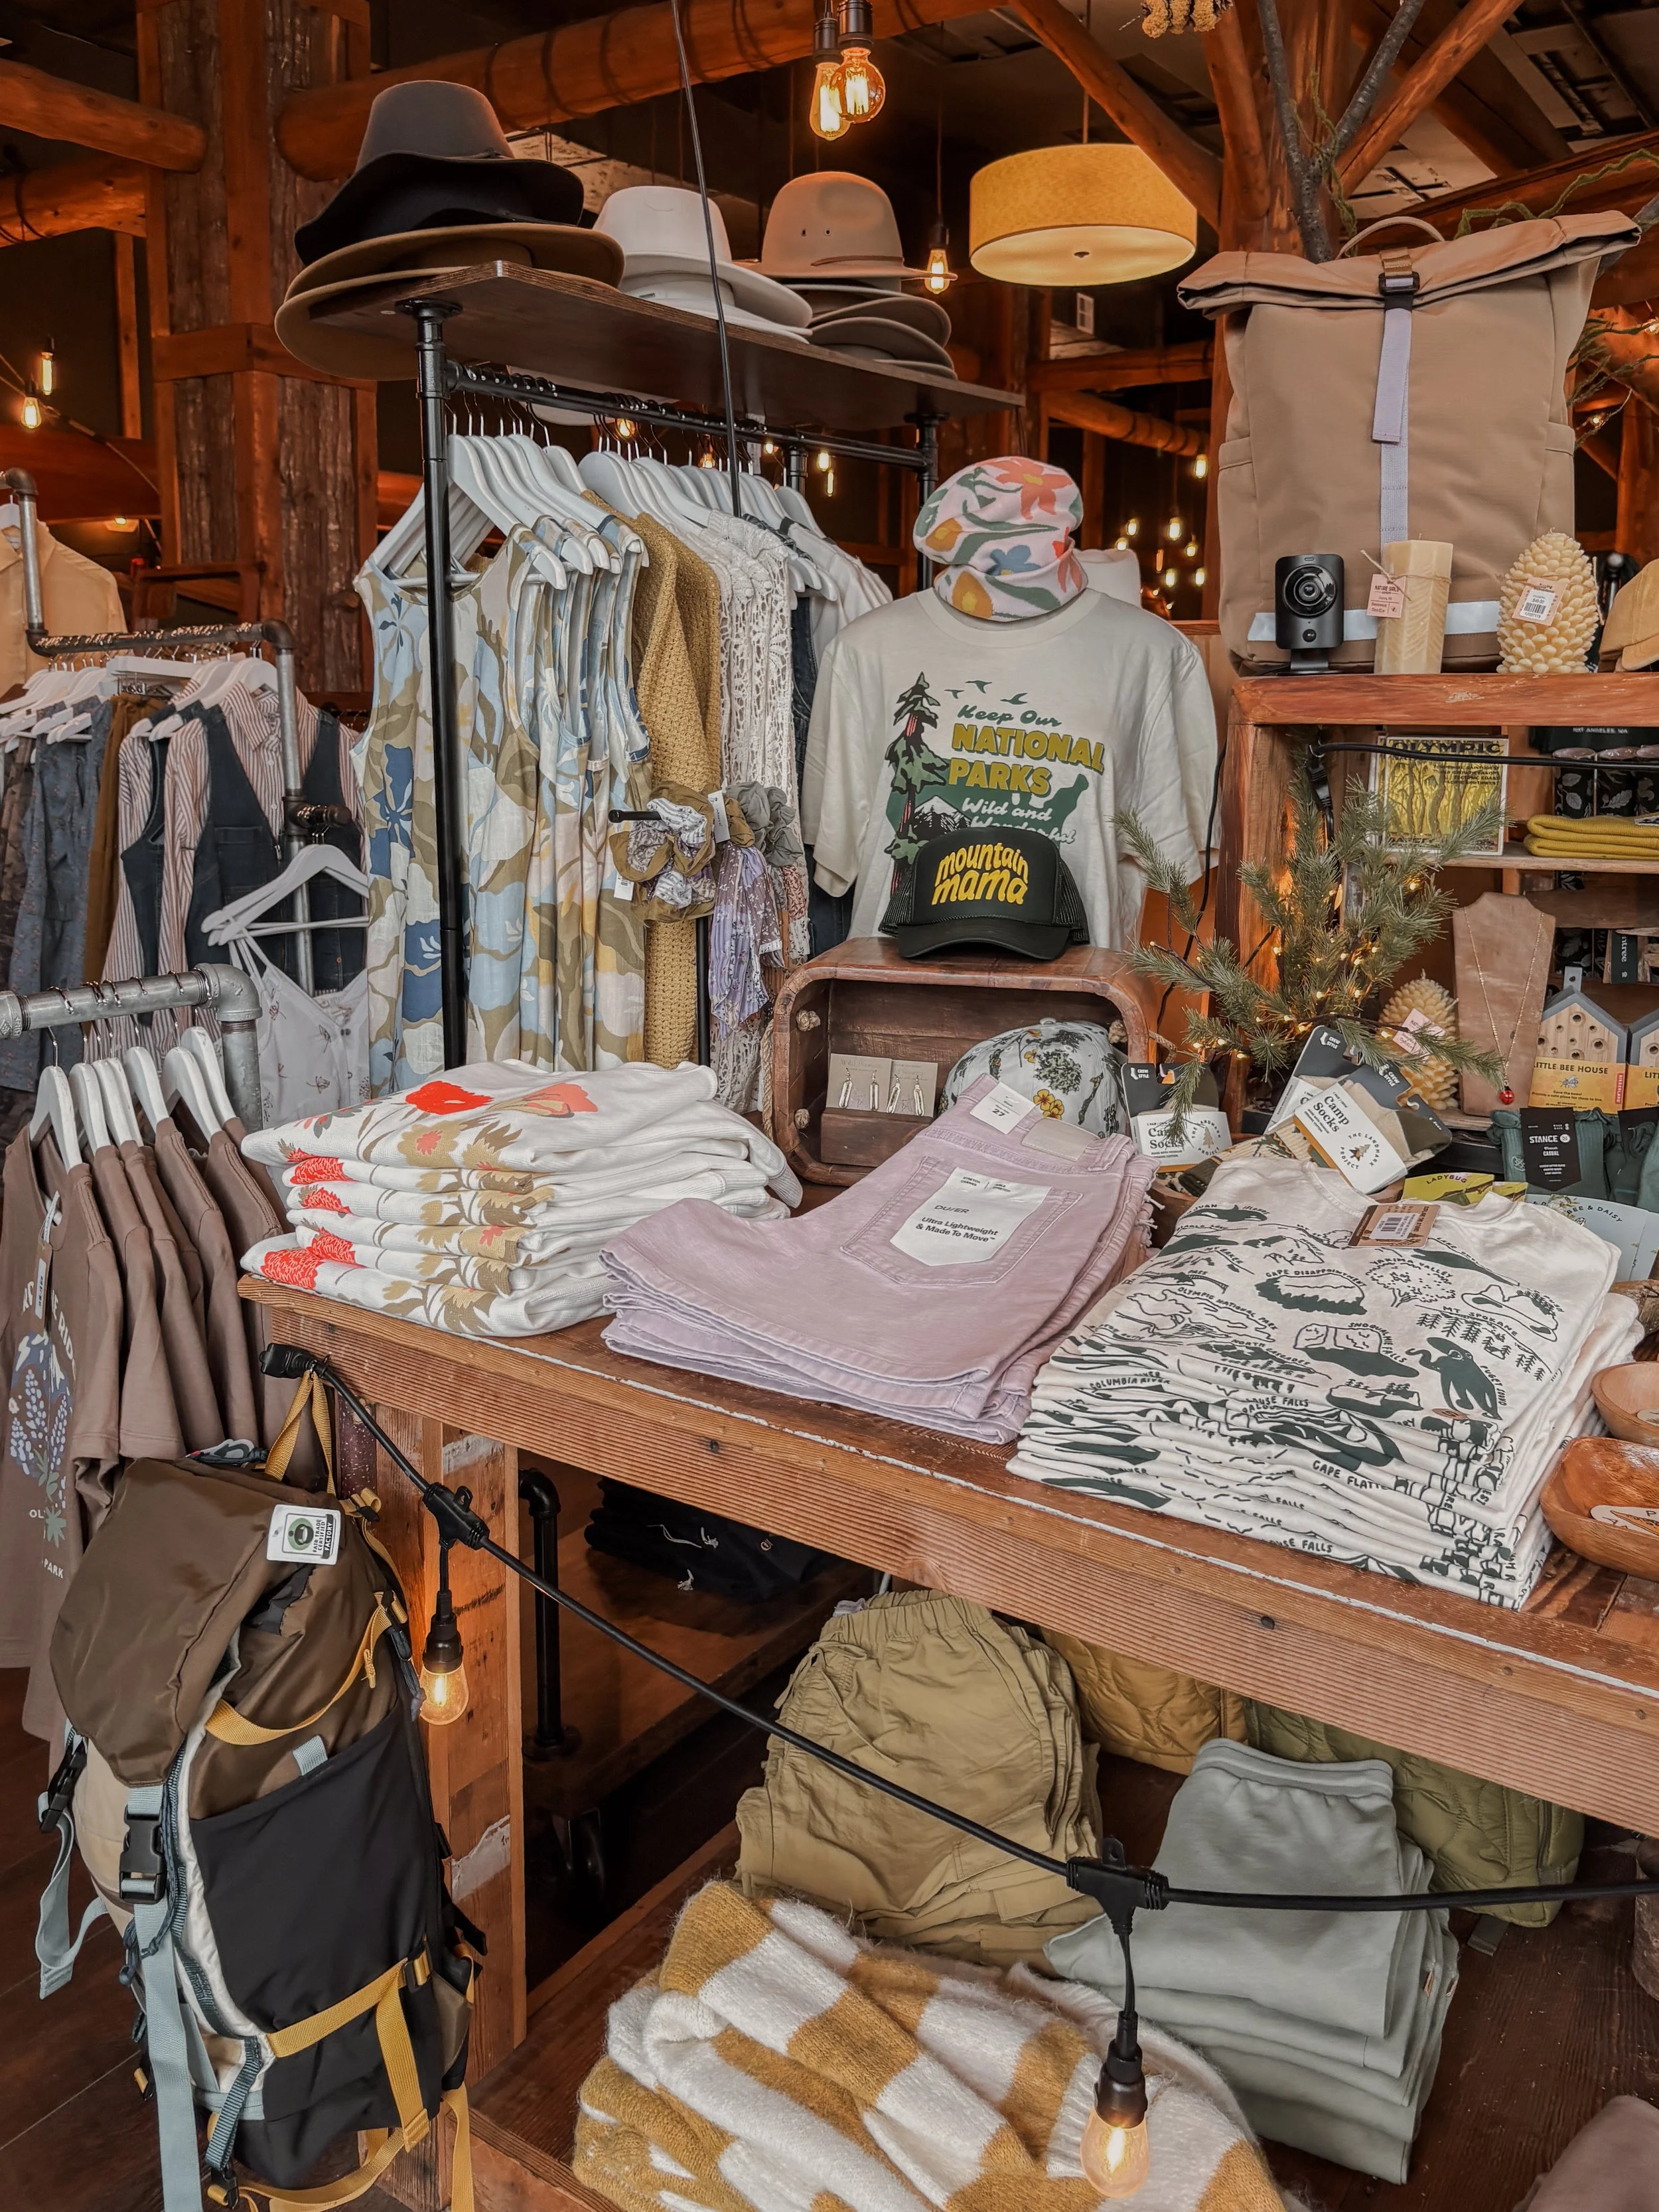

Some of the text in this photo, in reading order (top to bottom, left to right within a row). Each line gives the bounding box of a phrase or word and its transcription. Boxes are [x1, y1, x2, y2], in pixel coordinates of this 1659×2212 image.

[957, 704, 1062, 727] Keep Our
[952, 723, 1104, 776] NATIONAL
[1392, 741, 1502, 755] OLYMPIC
[948, 757, 1053, 798] PARKS
[962, 797, 1053, 822] Wild and
[934, 842, 1029, 887] mountain
[931, 869, 1029, 906] mama
[1327, 1041, 1338, 1049] STYLE
[1328, 1036, 1341, 1045] CREW
[1384, 1074, 1396, 1087] STYLE
[1388, 1071, 1401, 1084] CREW
[1313, 1102, 1340, 1132] Socks
[1324, 1096, 1350, 1125] Camp
[1200, 1120, 1222, 1138] ANDMARK
[1529, 1135, 1558, 1143] STANCE
[1198, 1147, 1220, 1155] PROJECT
[1340, 1147, 1359, 1169] PROJECT
[1364, 1134, 1380, 1167] LANDMARK
[1426, 1174, 1467, 1185] LADYBUG
[1566, 1206, 1583, 1215] BEE
[1597, 1207, 1623, 1222] DAISY
[926, 1225, 951, 1235] Made
[945, 1221, 999, 1236] Lightweight
[1220, 1248, 1244, 1264] BAKER
[1265, 1268, 1367, 1288] CAPE DISAPPOINTMENT
[1419, 1262, 1453, 1278] VALLEY
[1178, 1286, 1279, 1330] OLYMPIC NATIONAL PARK
[1467, 1311, 1518, 1337] SPOKANE
[1348, 1322, 1407, 1363] SNOQUALMIE FALLS
[1231, 1339, 1311, 1366] NORTH CASCADES
[1089, 1377, 1137, 1390] COLUMBIA
[1480, 1365, 1502, 1387] PUGET
[1282, 1396, 1309, 1407] FALLS
[1313, 1460, 1340, 1479] CAPE
[324, 1522, 333, 1551] FACTORY
[1302, 1540, 1333, 1553] FALLS
[44, 1558, 64, 1579] PARK
